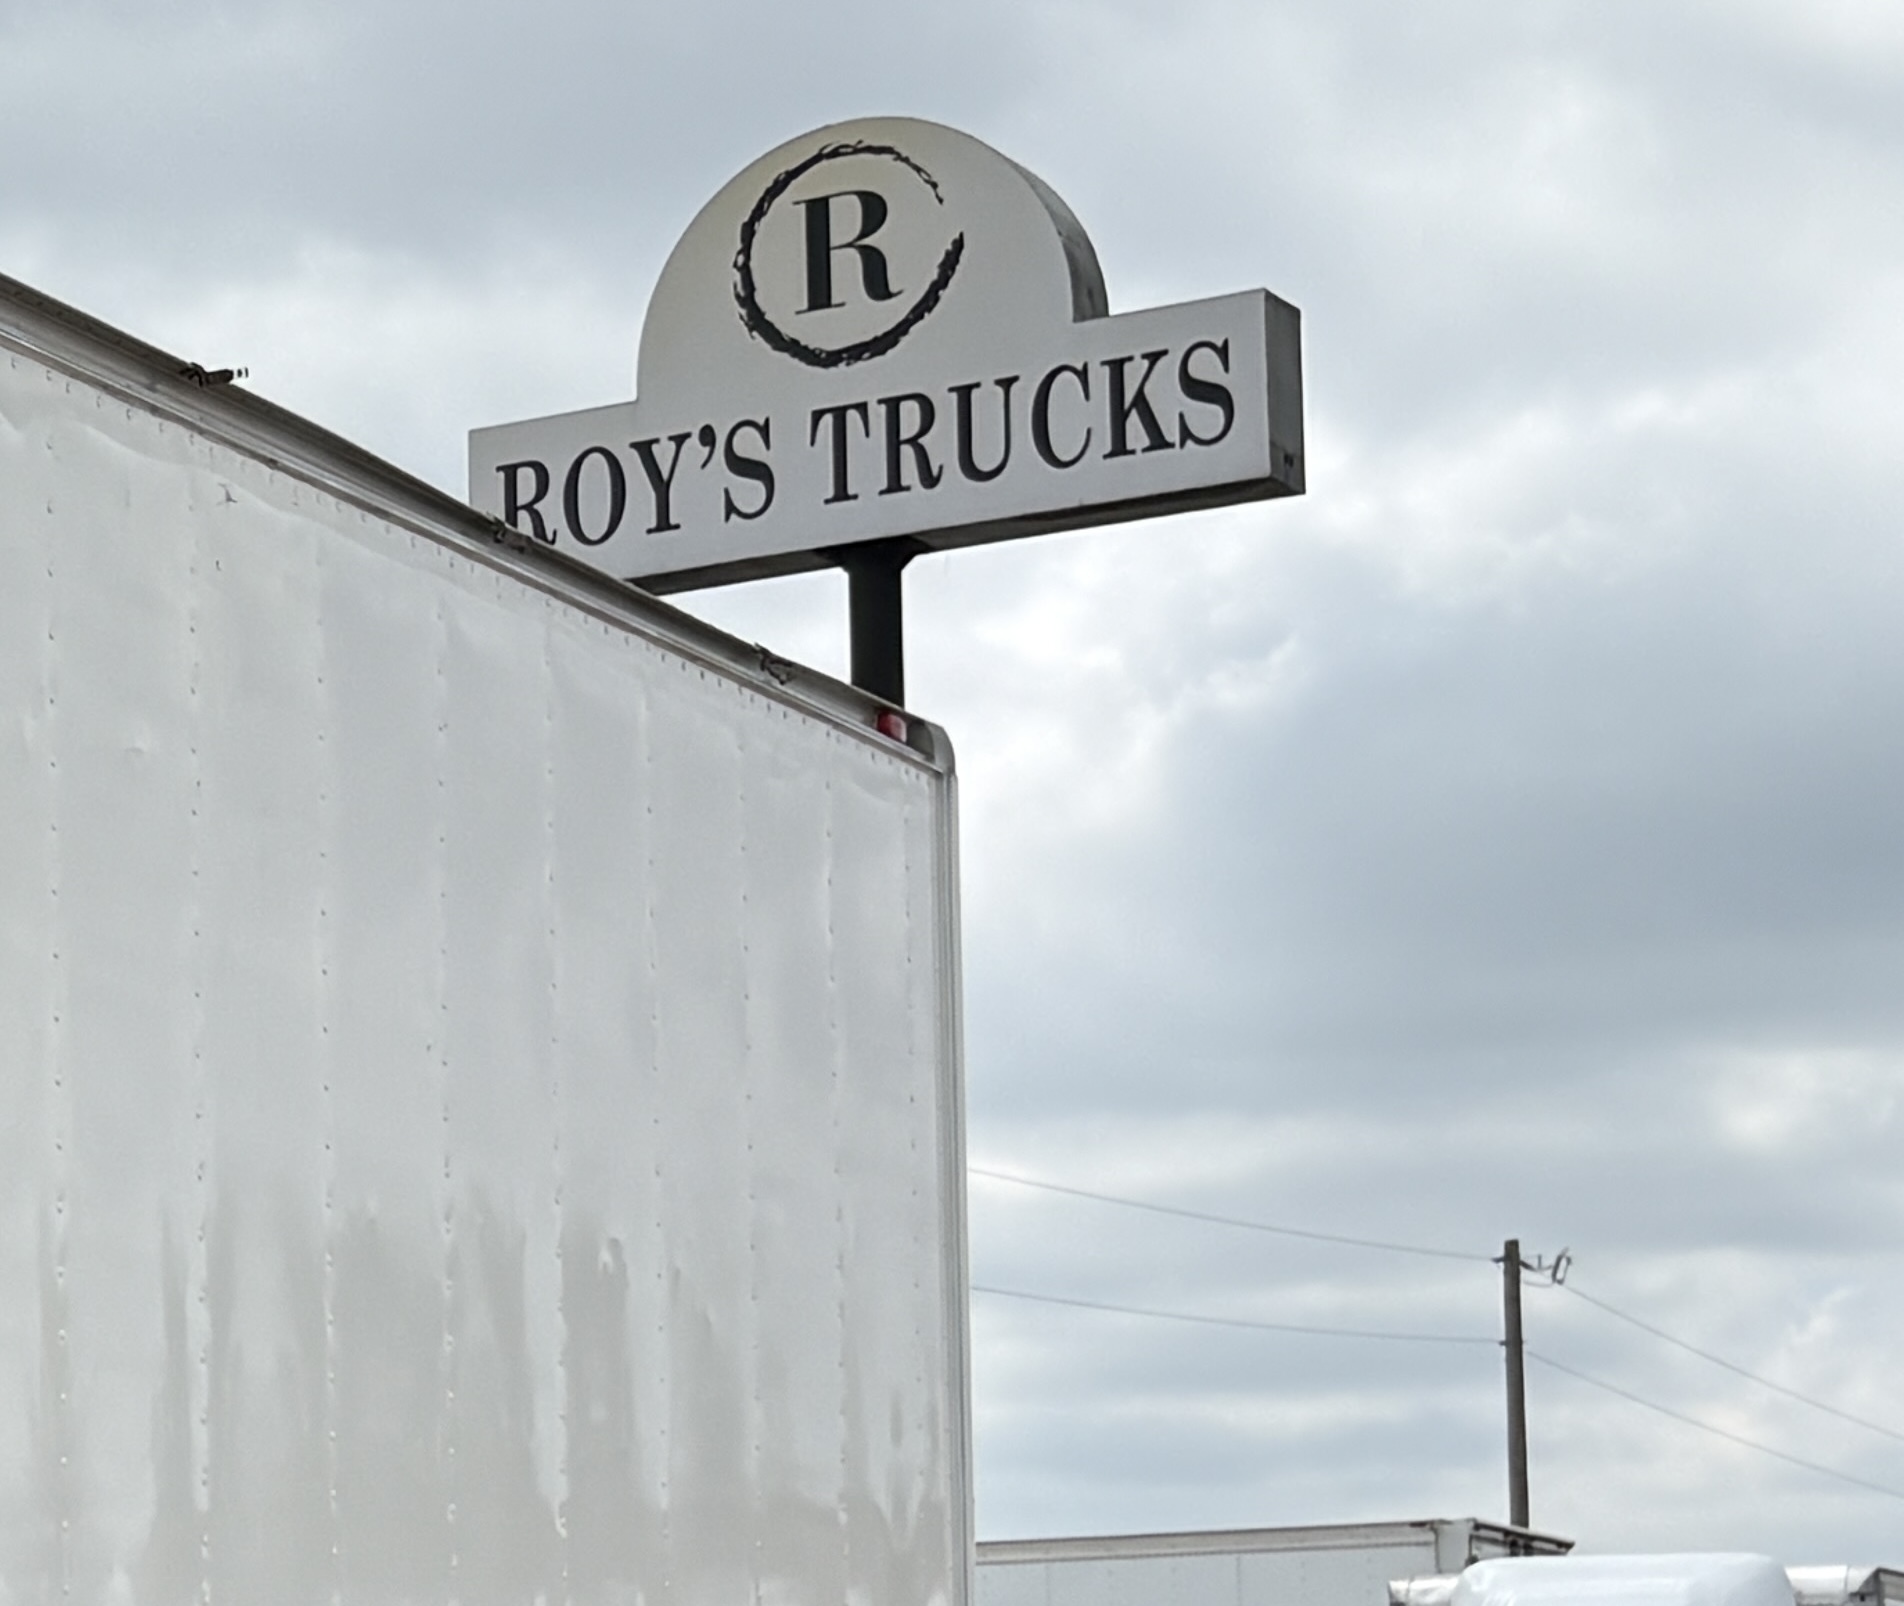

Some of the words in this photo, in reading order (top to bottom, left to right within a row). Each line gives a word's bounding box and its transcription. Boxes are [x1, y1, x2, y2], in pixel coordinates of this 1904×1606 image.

[792, 188, 904, 315] R
[496, 416, 776, 550] ROY'S
[810, 337, 1237, 507] TRUCKS
